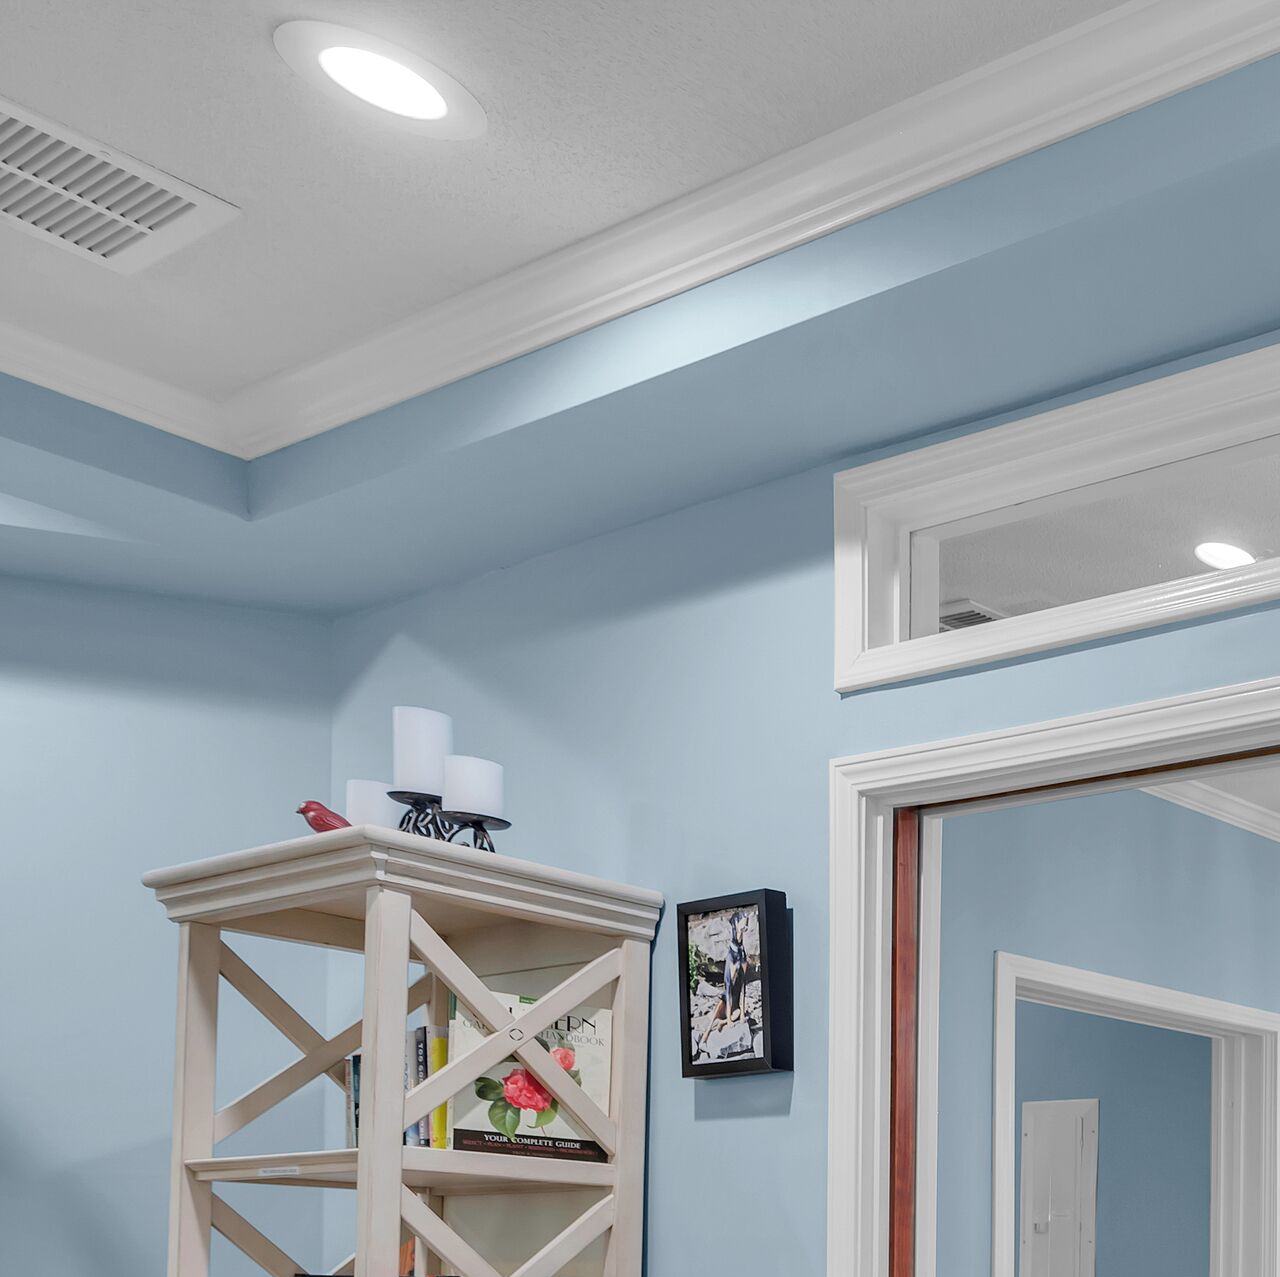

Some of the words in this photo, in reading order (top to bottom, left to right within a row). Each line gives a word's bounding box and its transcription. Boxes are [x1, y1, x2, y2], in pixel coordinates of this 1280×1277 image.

[484, 1134, 508, 1143] YOUR
[511, 1137, 553, 1147] COMPLETE
[555, 1140, 581, 1149] GUIDE
